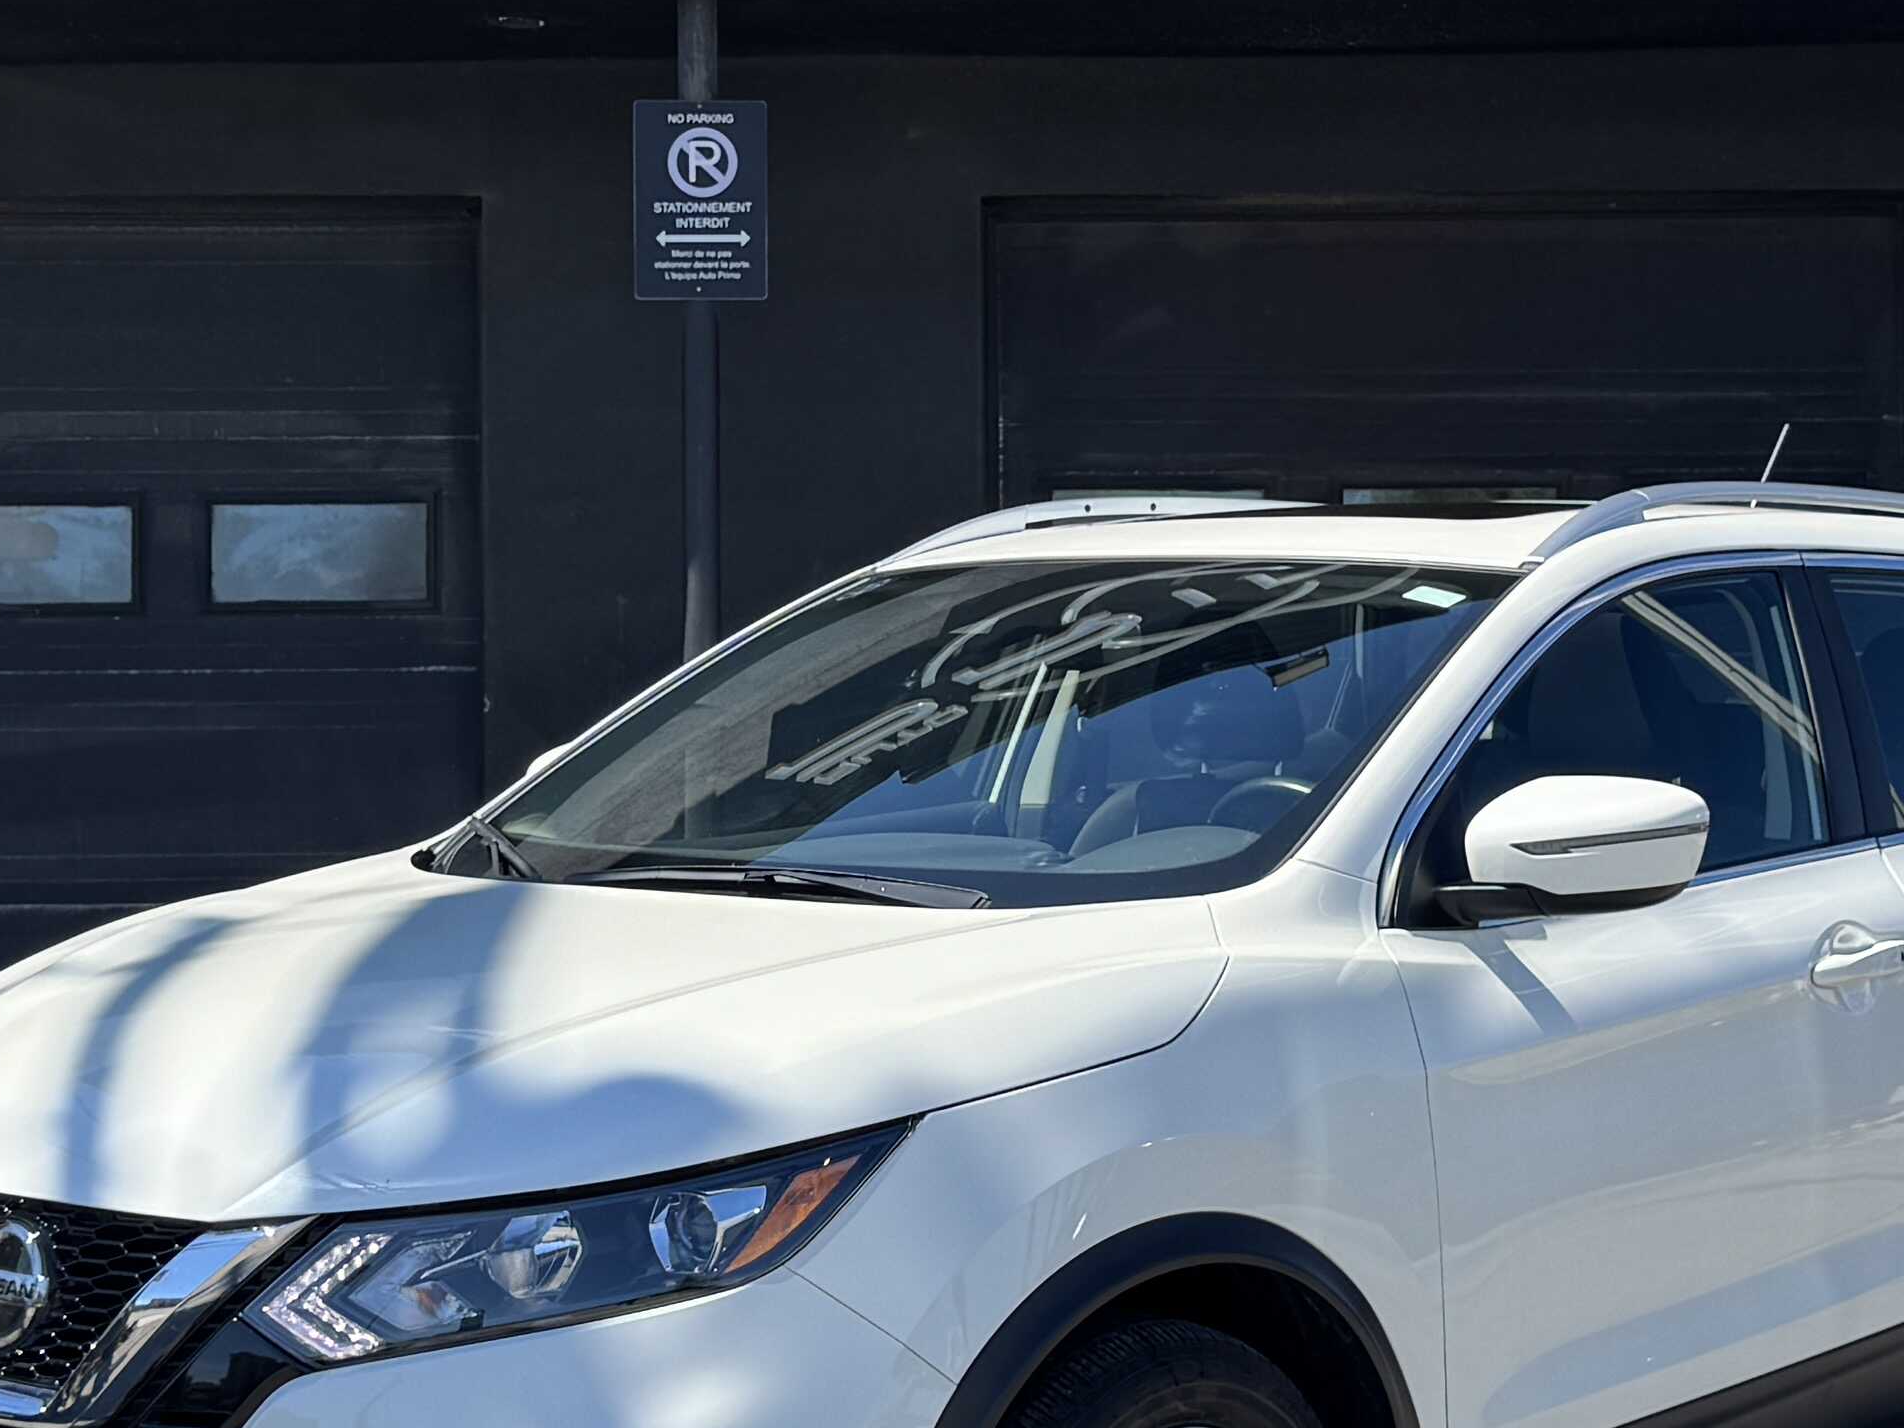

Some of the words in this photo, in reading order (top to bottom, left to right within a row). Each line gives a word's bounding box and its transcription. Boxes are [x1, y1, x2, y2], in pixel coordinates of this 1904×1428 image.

[667, 113, 685, 124] NO
[686, 113, 735, 124] PARKING
[653, 202, 753, 214] STATIONNEMENT
[675, 217, 731, 229] INTERDIT
